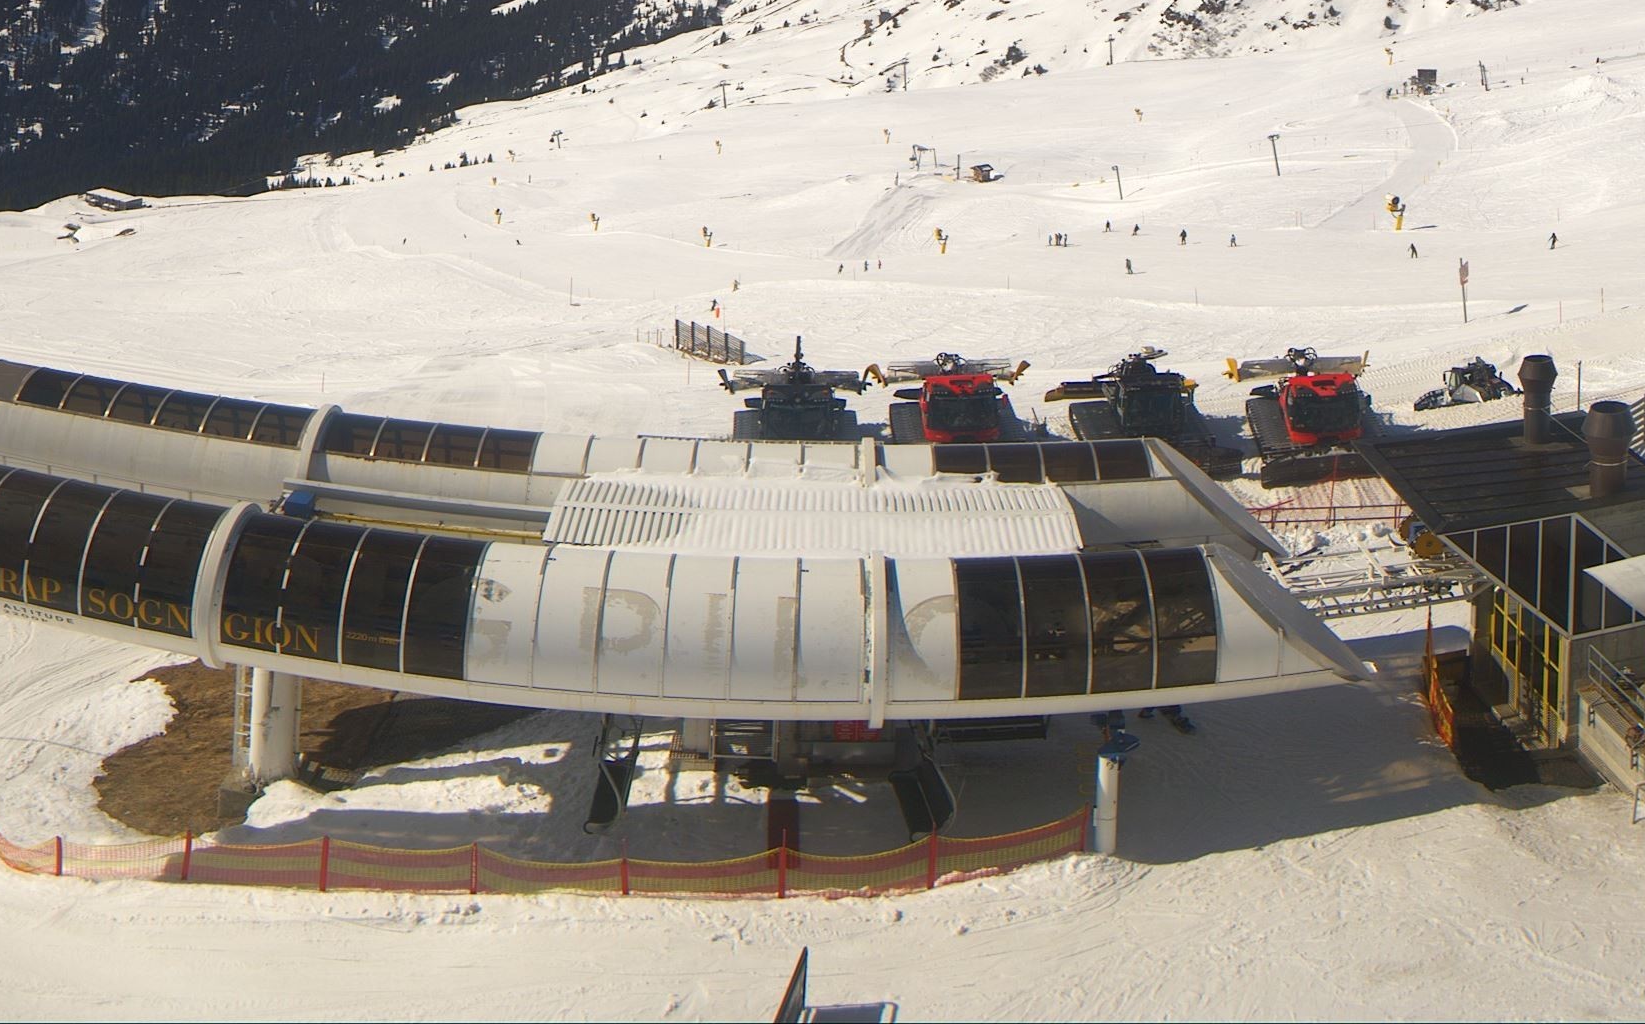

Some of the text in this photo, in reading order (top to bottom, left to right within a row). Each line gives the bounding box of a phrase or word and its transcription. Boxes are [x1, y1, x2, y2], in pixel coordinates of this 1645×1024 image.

[3, 603, 75, 625] ALTITUDE
[87, 588, 191, 633] SOGN
[224, 613, 323, 654] GION
